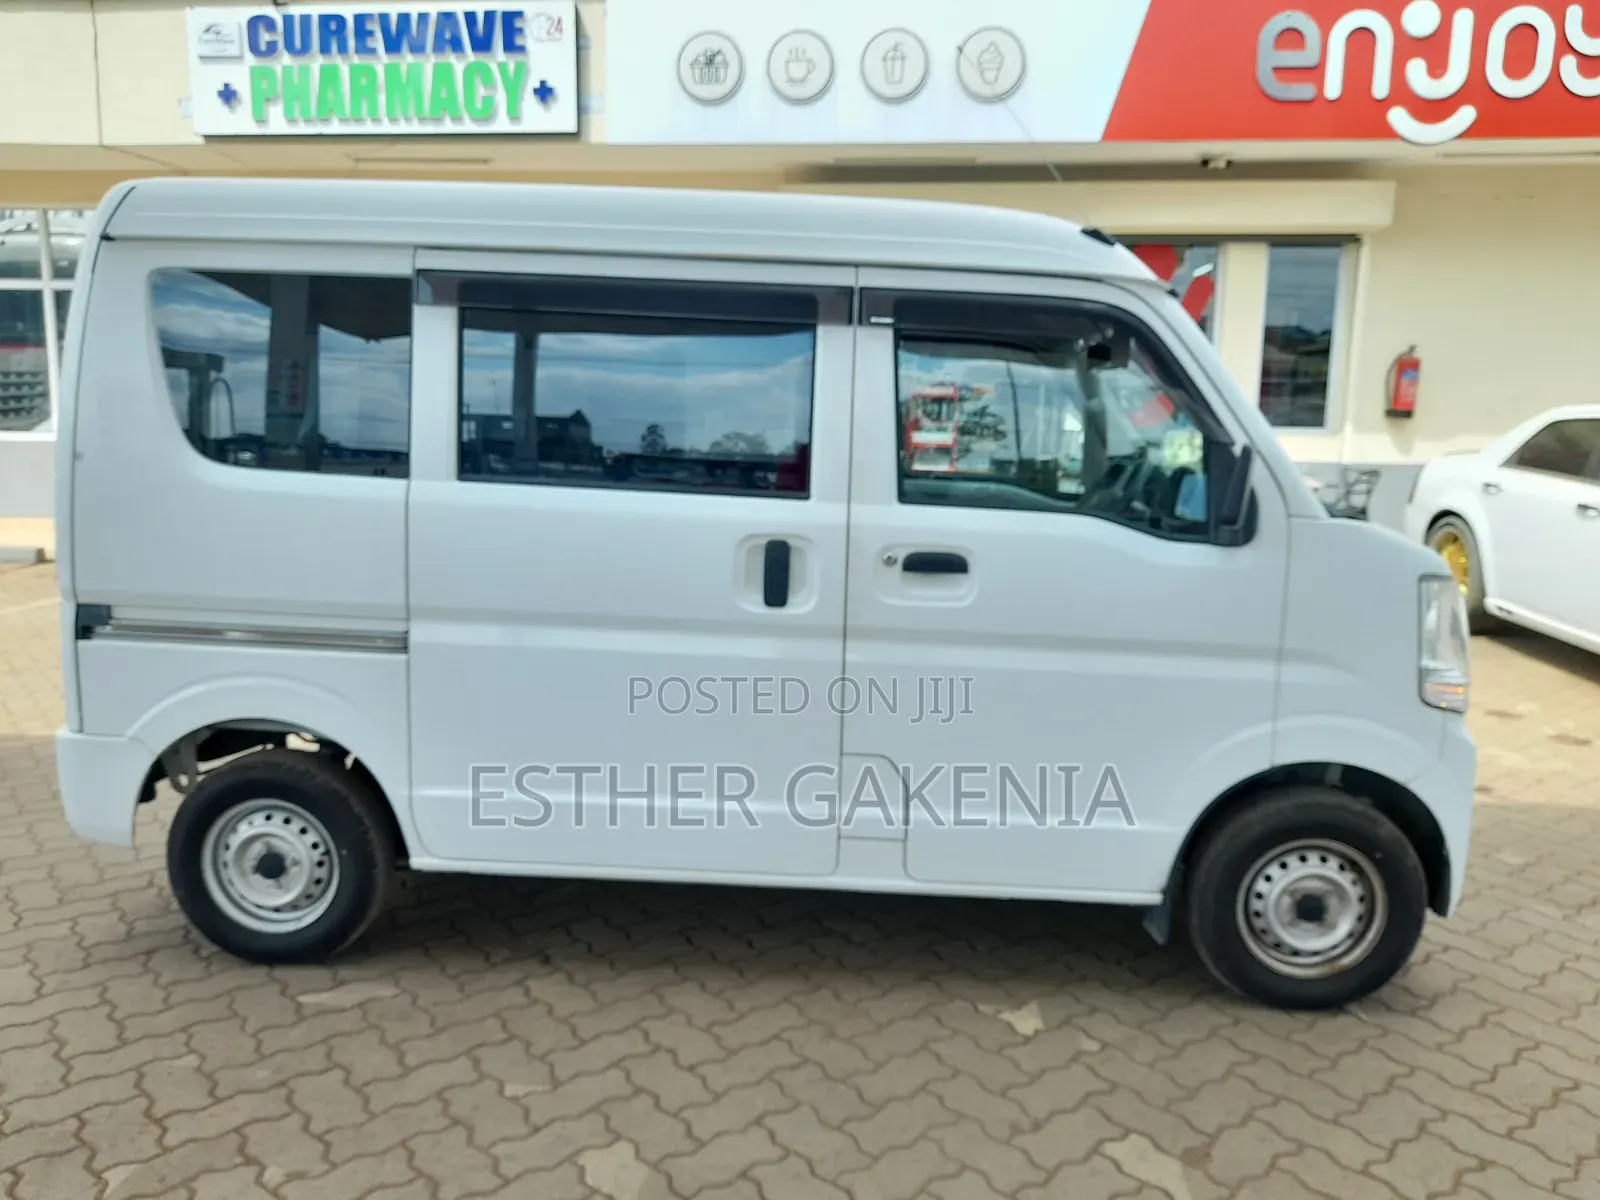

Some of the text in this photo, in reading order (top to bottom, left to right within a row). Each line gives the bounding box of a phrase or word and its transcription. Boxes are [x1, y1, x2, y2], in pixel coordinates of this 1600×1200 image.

[247, 10, 526, 57] CUREWAVE
[547, 16, 563, 36] 24
[249, 60, 527, 121] PHARMACY
